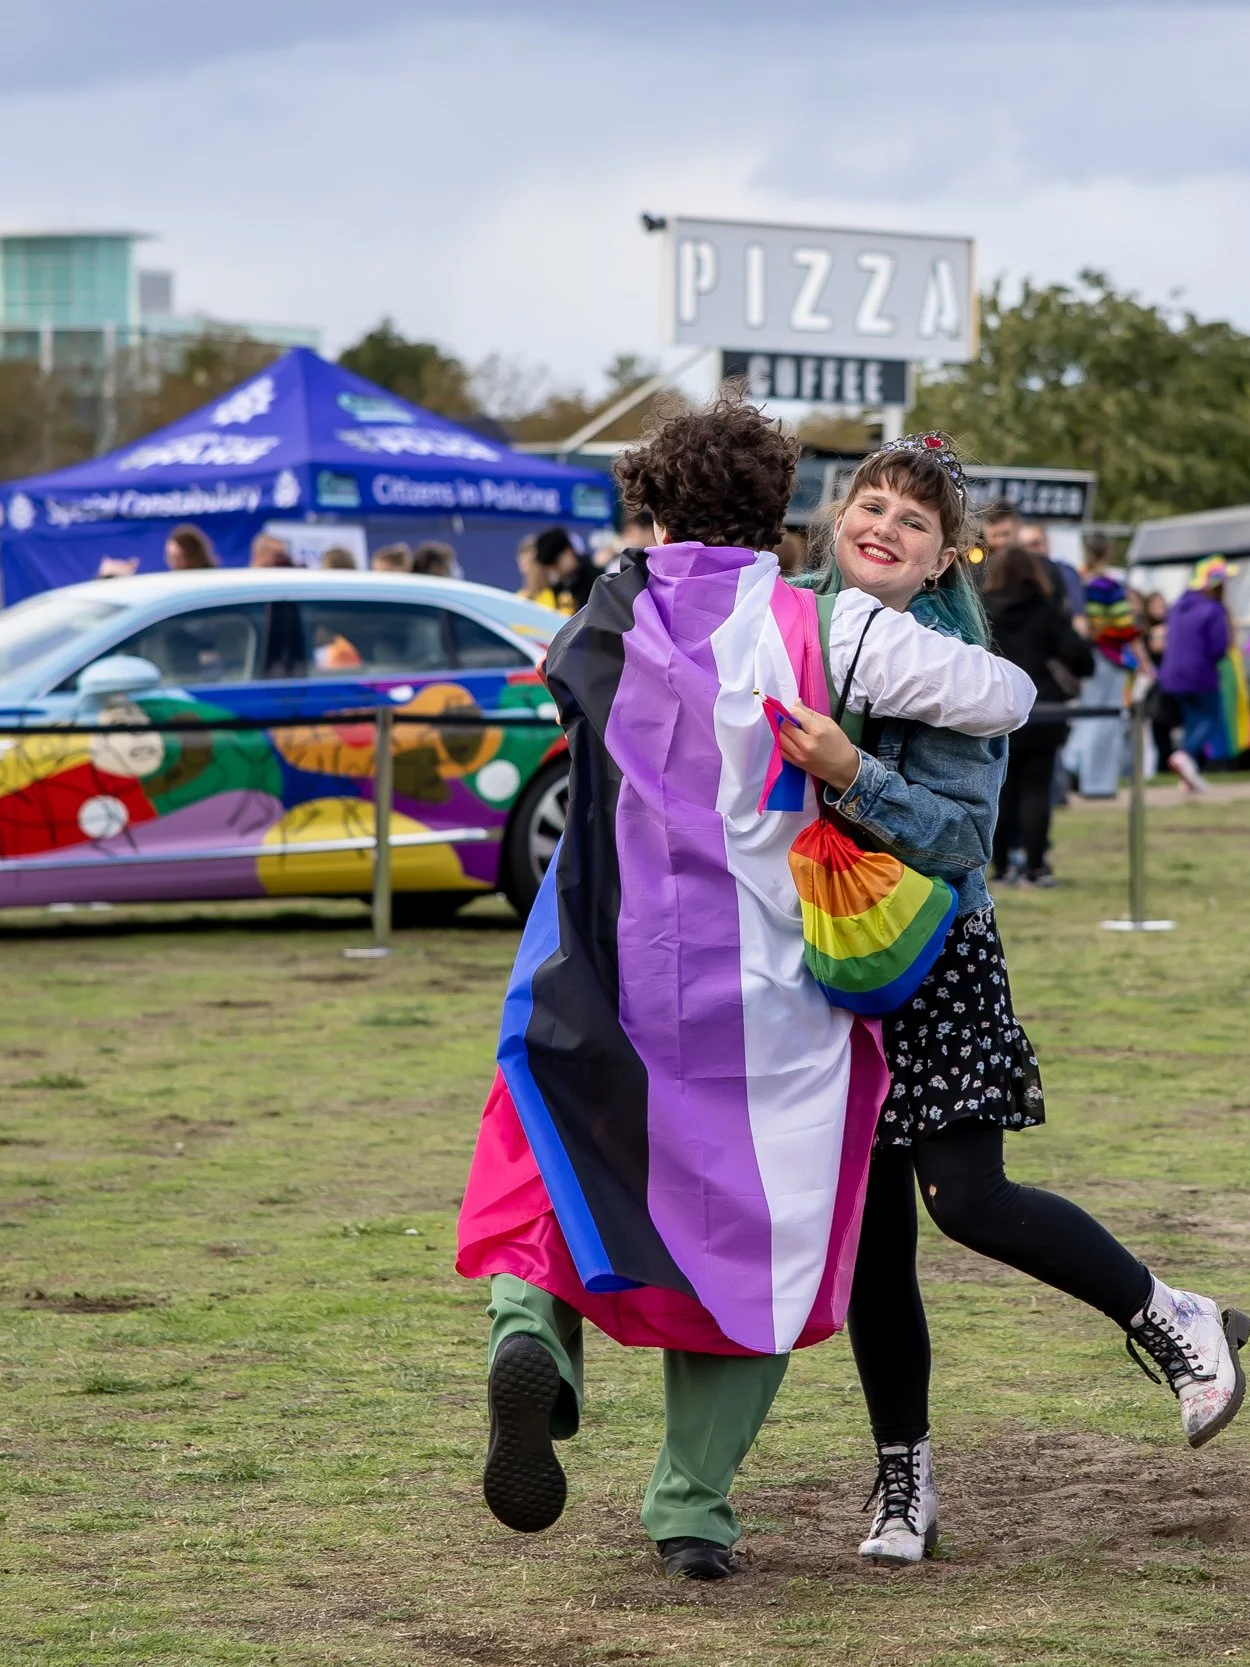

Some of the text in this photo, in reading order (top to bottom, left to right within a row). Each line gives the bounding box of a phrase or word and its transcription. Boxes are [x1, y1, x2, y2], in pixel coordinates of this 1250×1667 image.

[679, 238, 960, 338] PIZZA
[747, 356, 883, 406] COFFEE
[372, 474, 454, 507] Citizens
[455, 476, 480, 507] in
[480, 478, 562, 514] Policing
